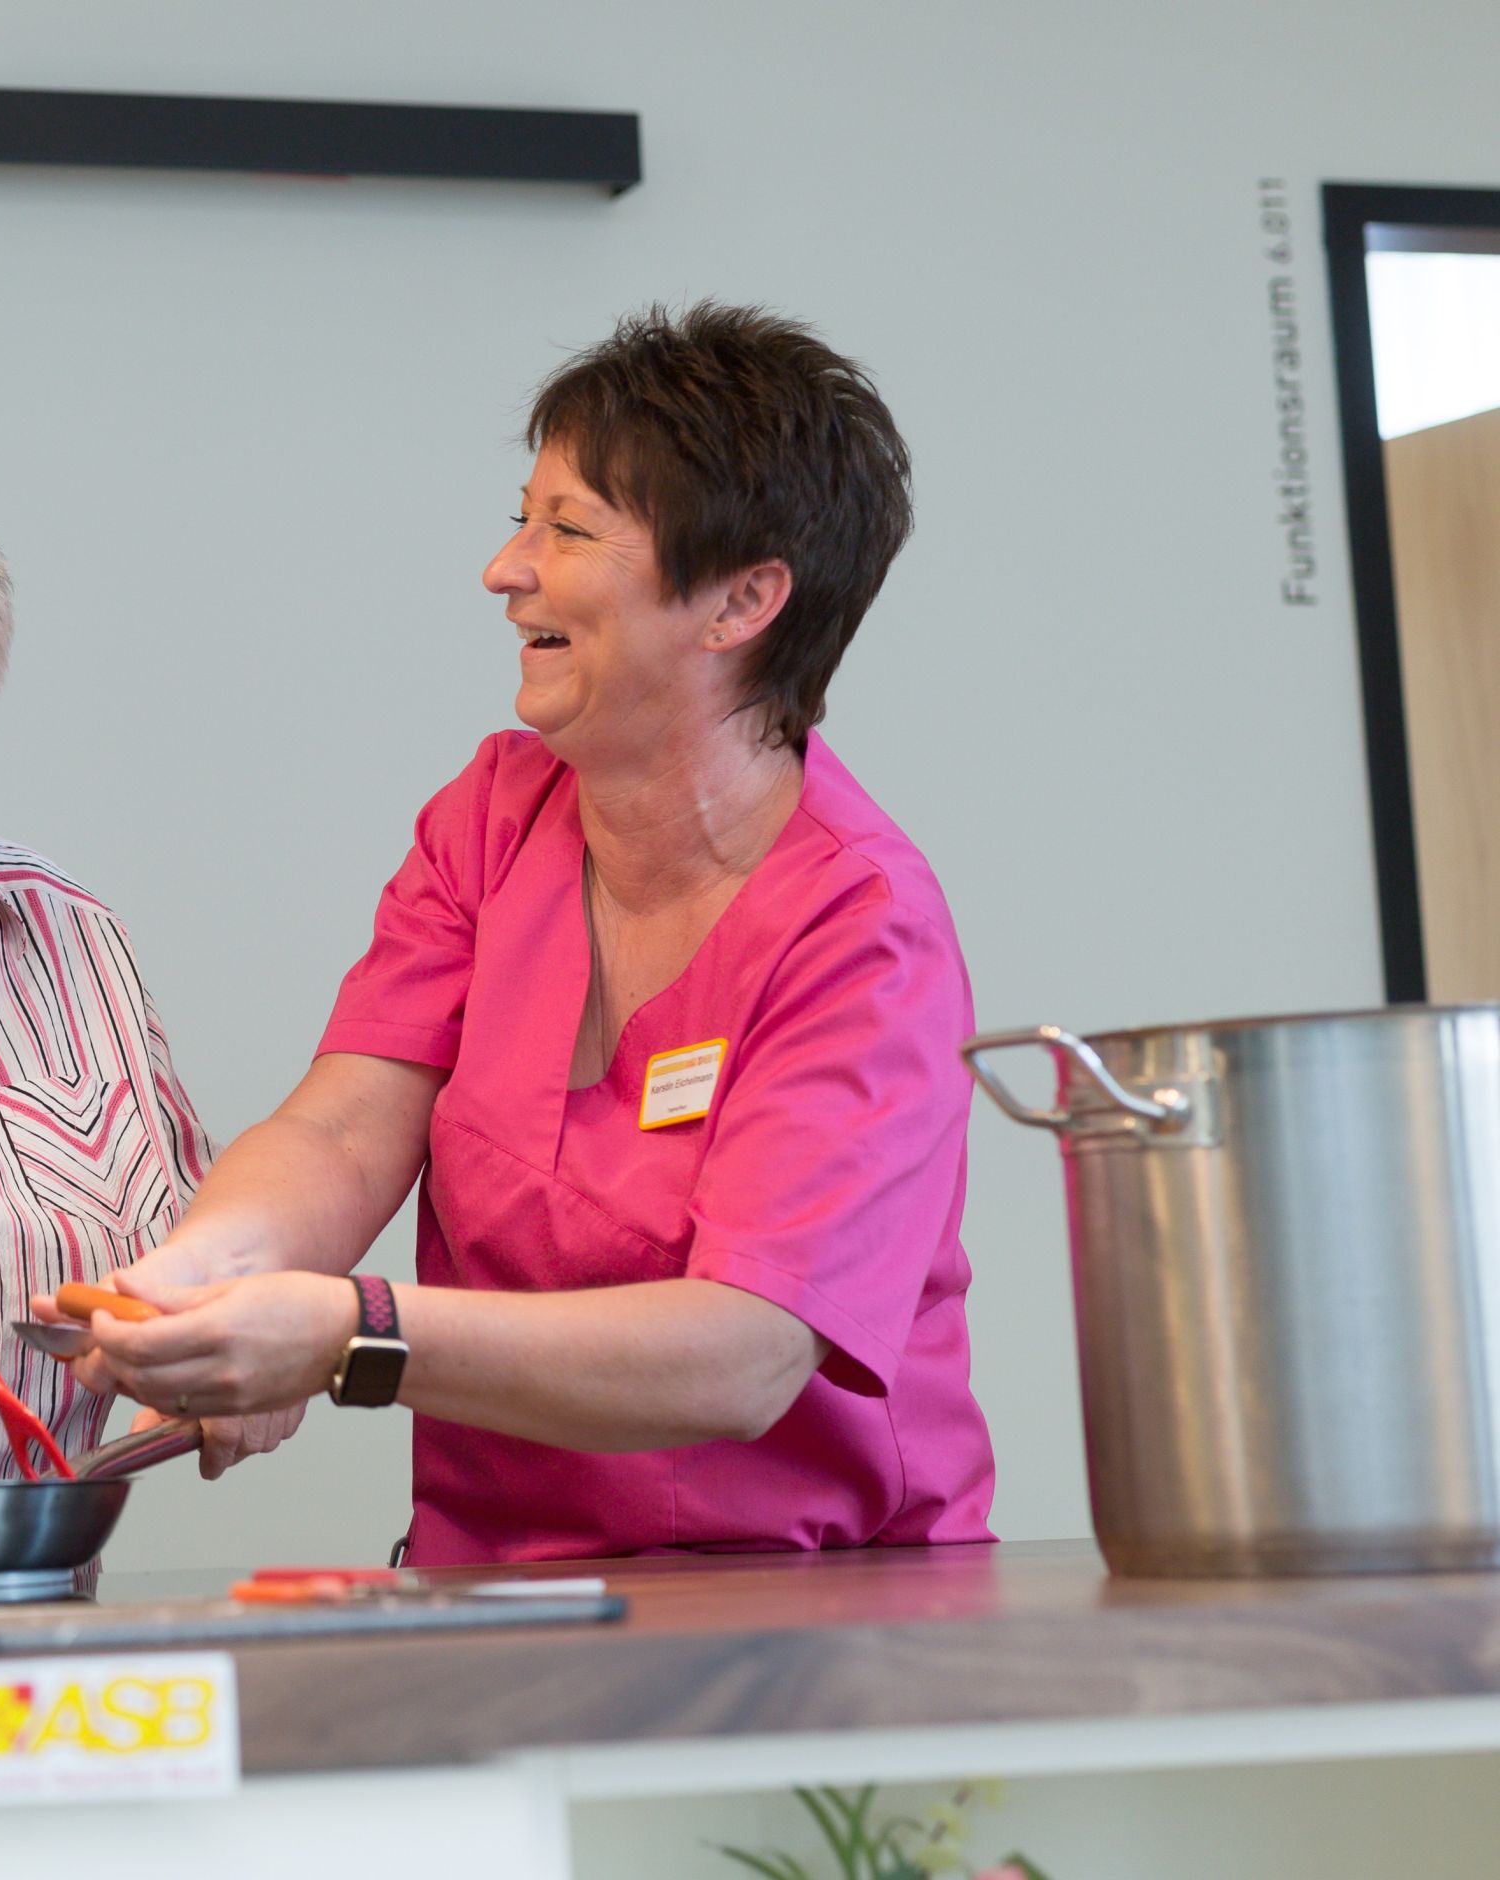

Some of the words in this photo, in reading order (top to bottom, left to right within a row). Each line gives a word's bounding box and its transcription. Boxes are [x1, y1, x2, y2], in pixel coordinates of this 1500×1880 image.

[1257, 178, 1293, 265] 6.011
[1268, 276, 1318, 606] Funktionsraum
[30, 1678, 214, 1754] ASB
